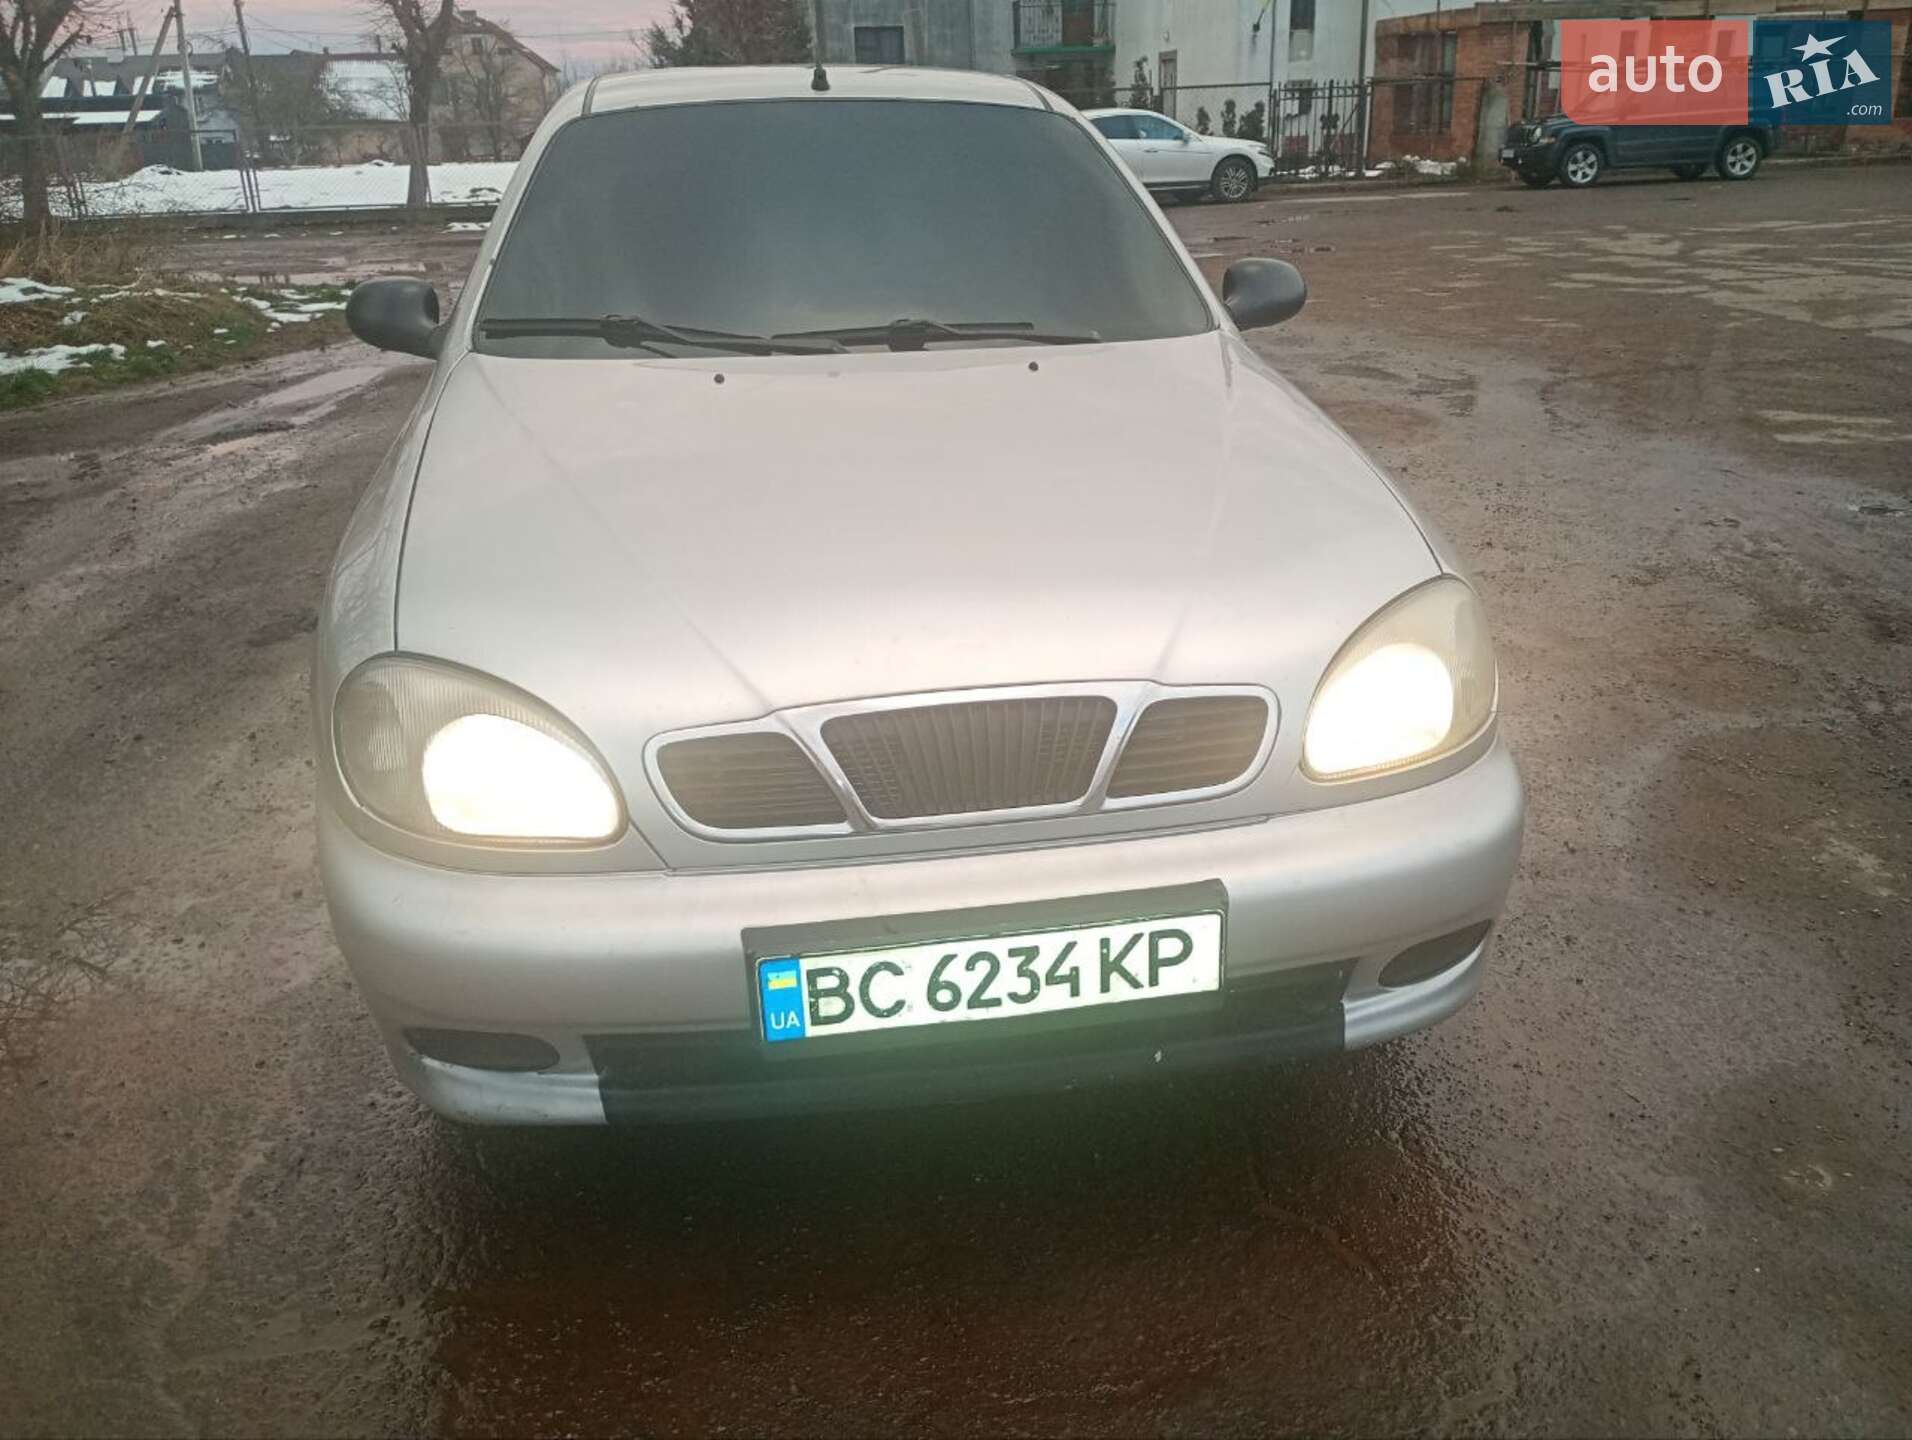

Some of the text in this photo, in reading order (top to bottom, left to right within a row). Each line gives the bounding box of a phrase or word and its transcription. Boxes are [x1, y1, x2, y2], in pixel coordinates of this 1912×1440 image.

[806, 929, 1194, 1027] BC 6234 KP
[771, 1012, 801, 1031] UA
